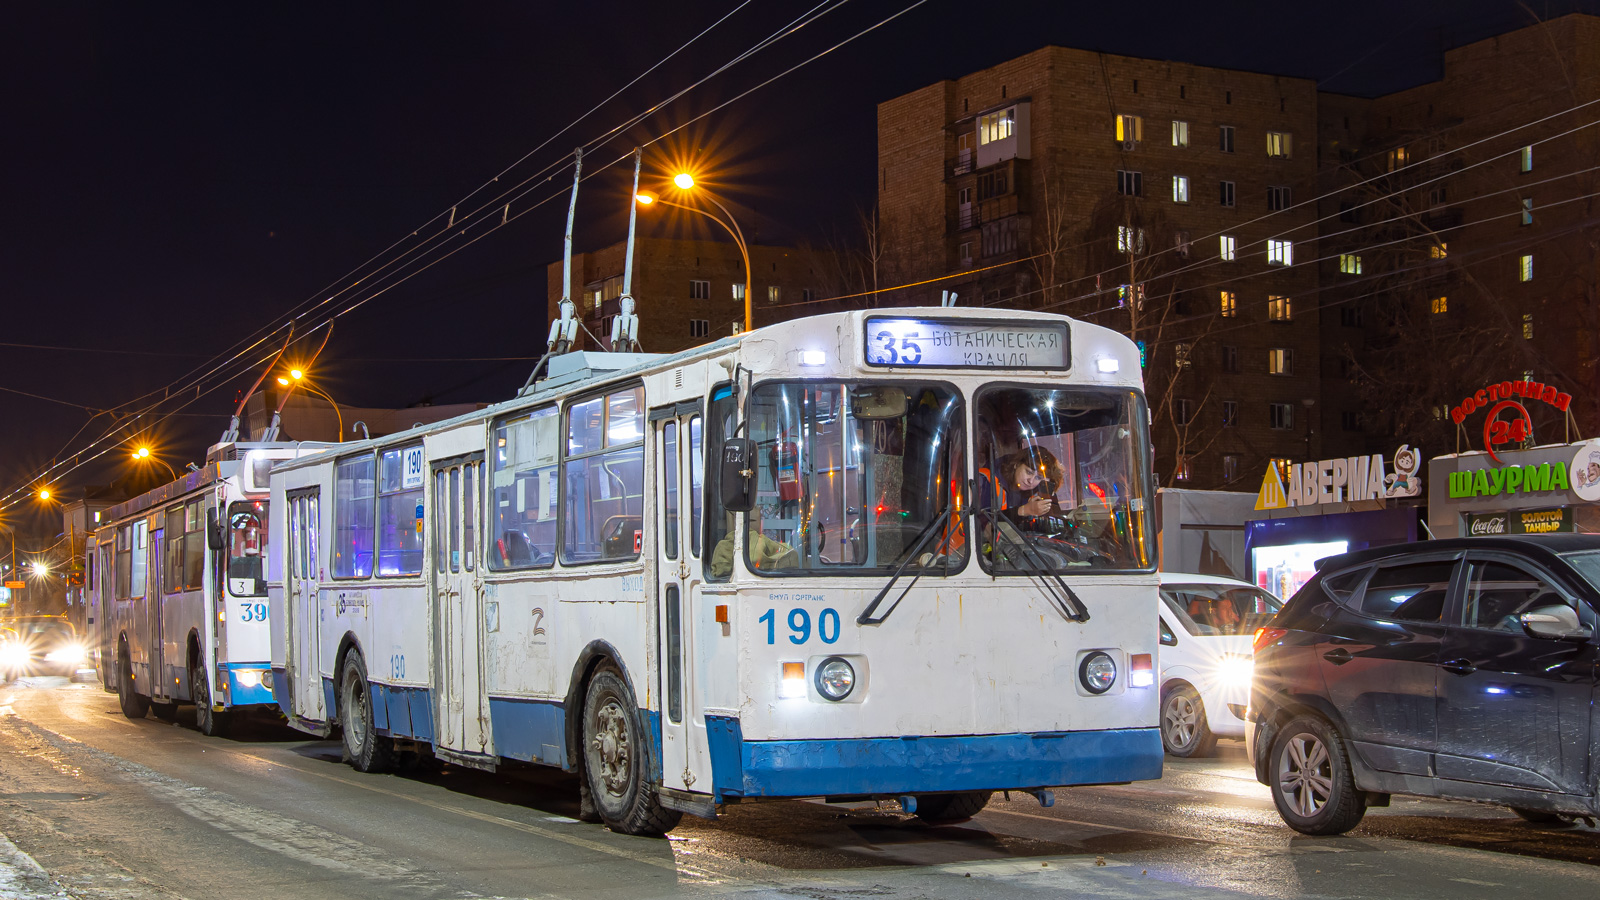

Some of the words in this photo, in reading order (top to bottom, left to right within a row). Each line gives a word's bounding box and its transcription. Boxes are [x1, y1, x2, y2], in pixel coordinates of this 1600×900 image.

[875, 330, 922, 364] 35
[932, 330, 1058, 348] БОТАНИЧЕСКАЯ
[1491, 419, 1527, 444] 24
[408, 450, 421, 474] 190
[1449, 462, 1569, 498] ШАУРМА
[1521, 509, 1563, 523] ЗОЛОТОЙ
[1524, 521, 1560, 533] ТАНДЫР
[238, 581, 245, 593] 3
[622, 576, 643, 592] ВЫХОД
[240, 603, 270, 622] 39
[339, 592, 346, 614] 35
[758, 607, 841, 645] 190
[390, 654, 405, 679] 190
